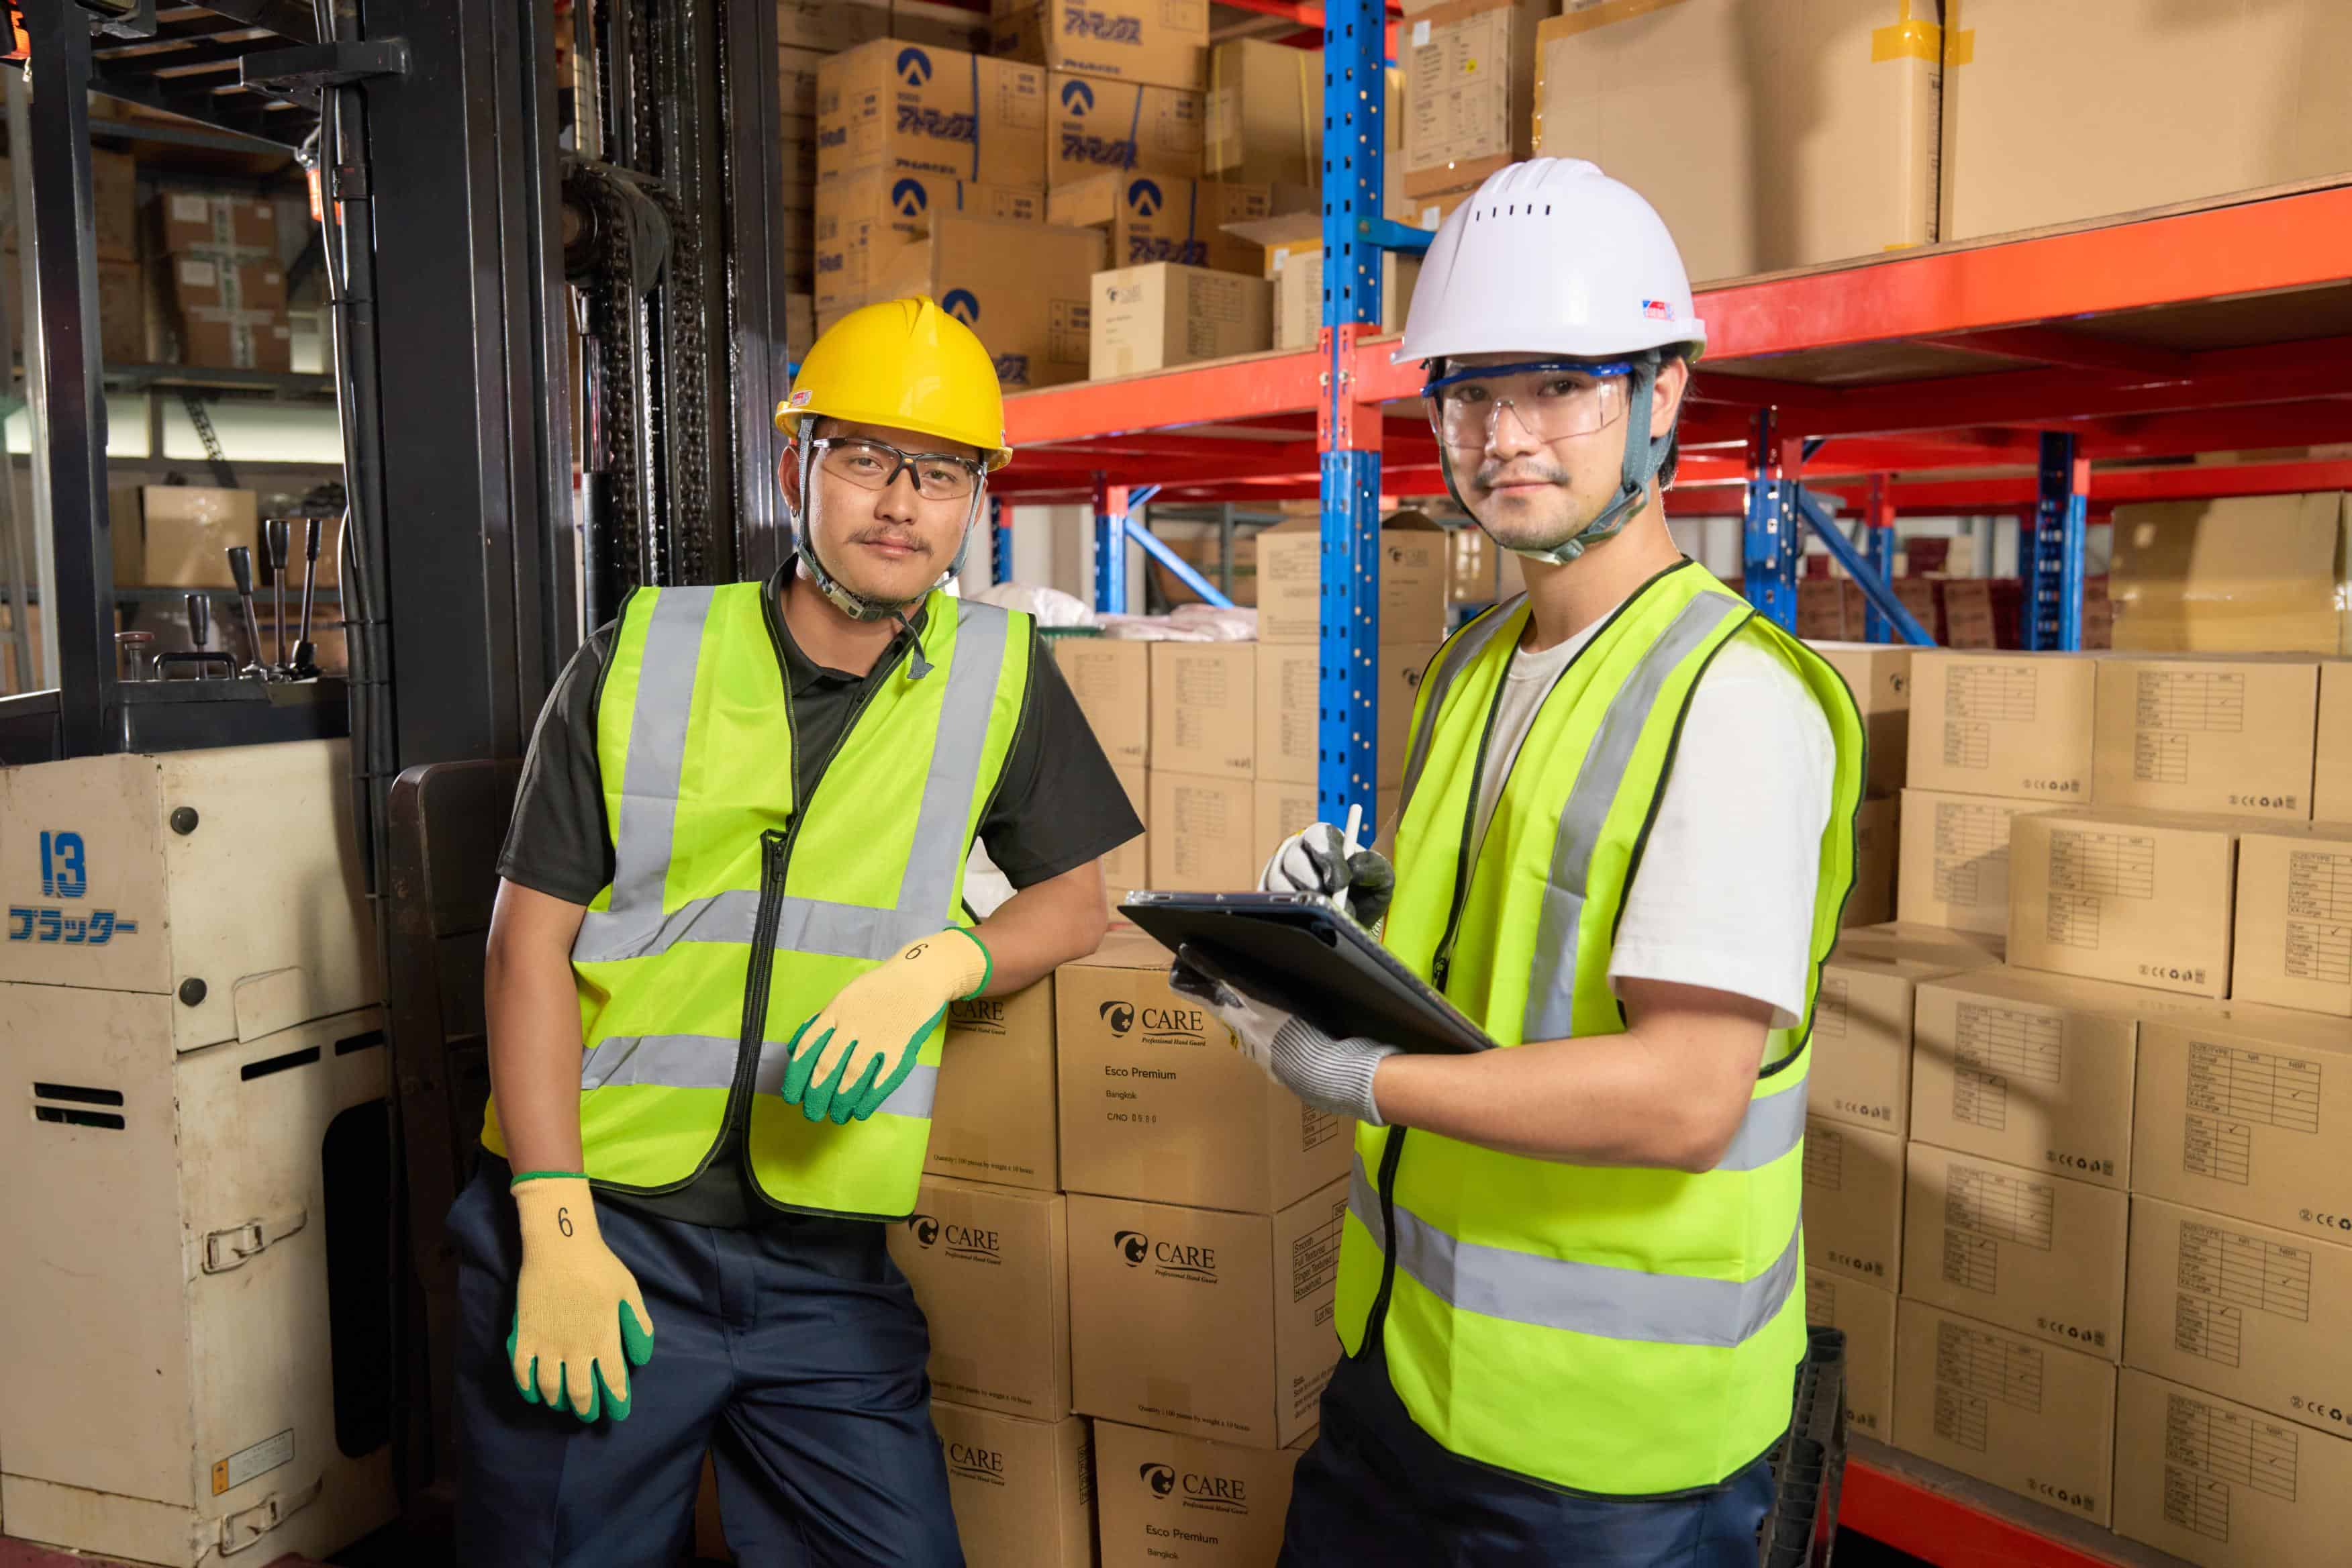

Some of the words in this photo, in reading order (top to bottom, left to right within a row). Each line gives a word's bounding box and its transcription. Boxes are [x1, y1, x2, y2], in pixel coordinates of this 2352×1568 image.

[40, 831, 87, 897] 13
[905, 943, 929, 960] 6
[1142, 1008, 1204, 1032] CARE
[1142, 1036, 1173, 1045] Professional
[1173, 1038, 1188, 1046] Hand
[1105, 1066, 1128, 1077] Esco
[1132, 1067, 1177, 1081] Premium
[1106, 1089, 1137, 1100] Bangkok
[1107, 1112, 1128, 1122] C/NO
[558, 1207, 573, 1237] 6
[945, 1224, 999, 1252] CARE
[1294, 1236, 1314, 1255] Smooth
[1155, 1242, 1216, 1269] CARE
[950, 1443, 1003, 1472] CARE
[1183, 1473, 1246, 1500] CARE
[1146, 1524, 1170, 1537] Esco
[1173, 1528, 1219, 1545] Premium
[1147, 1548, 1178, 1560] Bangkok
